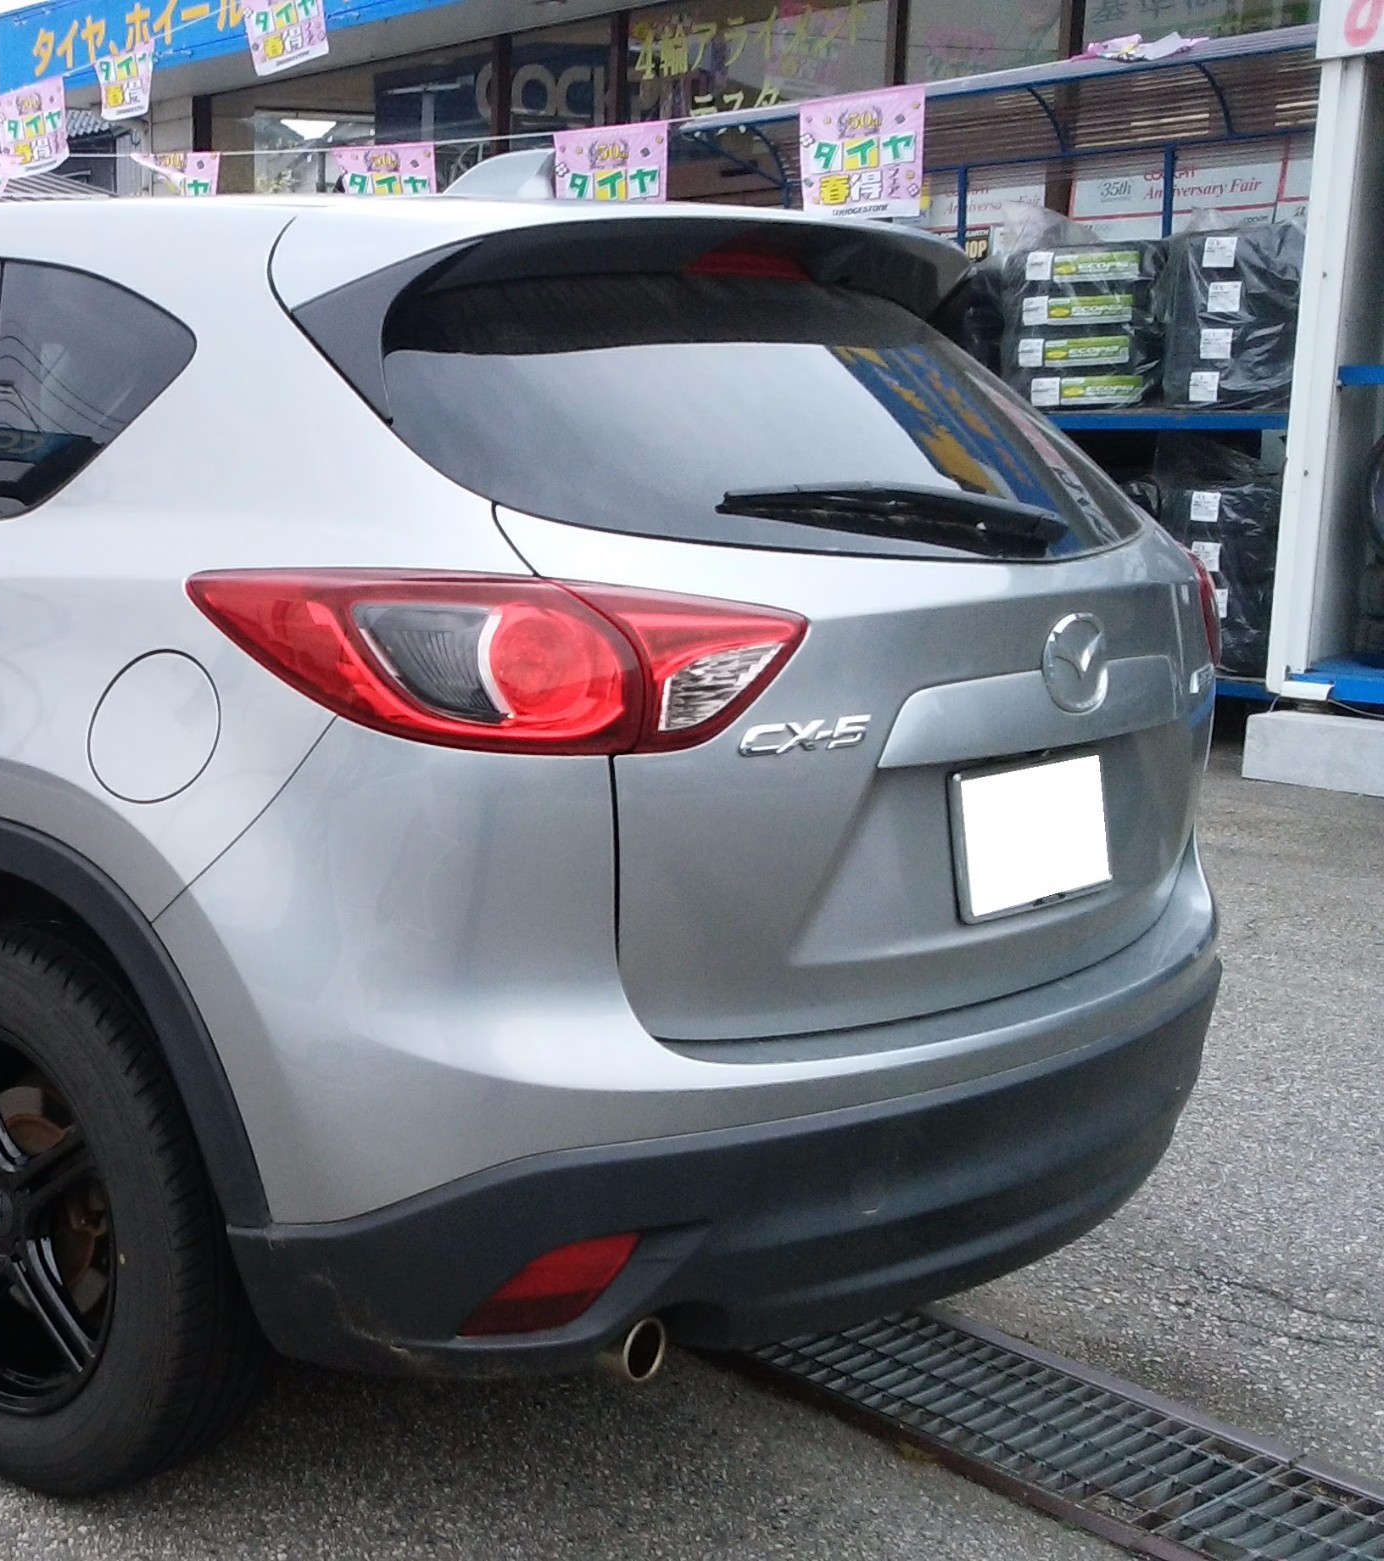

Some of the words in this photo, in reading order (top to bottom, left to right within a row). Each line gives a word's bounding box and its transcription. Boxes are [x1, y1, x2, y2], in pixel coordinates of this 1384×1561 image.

[812, 134, 915, 169] タイヤ
[568, 168, 658, 200] タイヤ
[819, 170, 884, 205] 春得
[1100, 180, 1132, 197] 35th
[1142, 181, 1228, 200] Aniversary
[1229, 177, 1263, 193] Fair
[738, 714, 872, 757] CX-5
